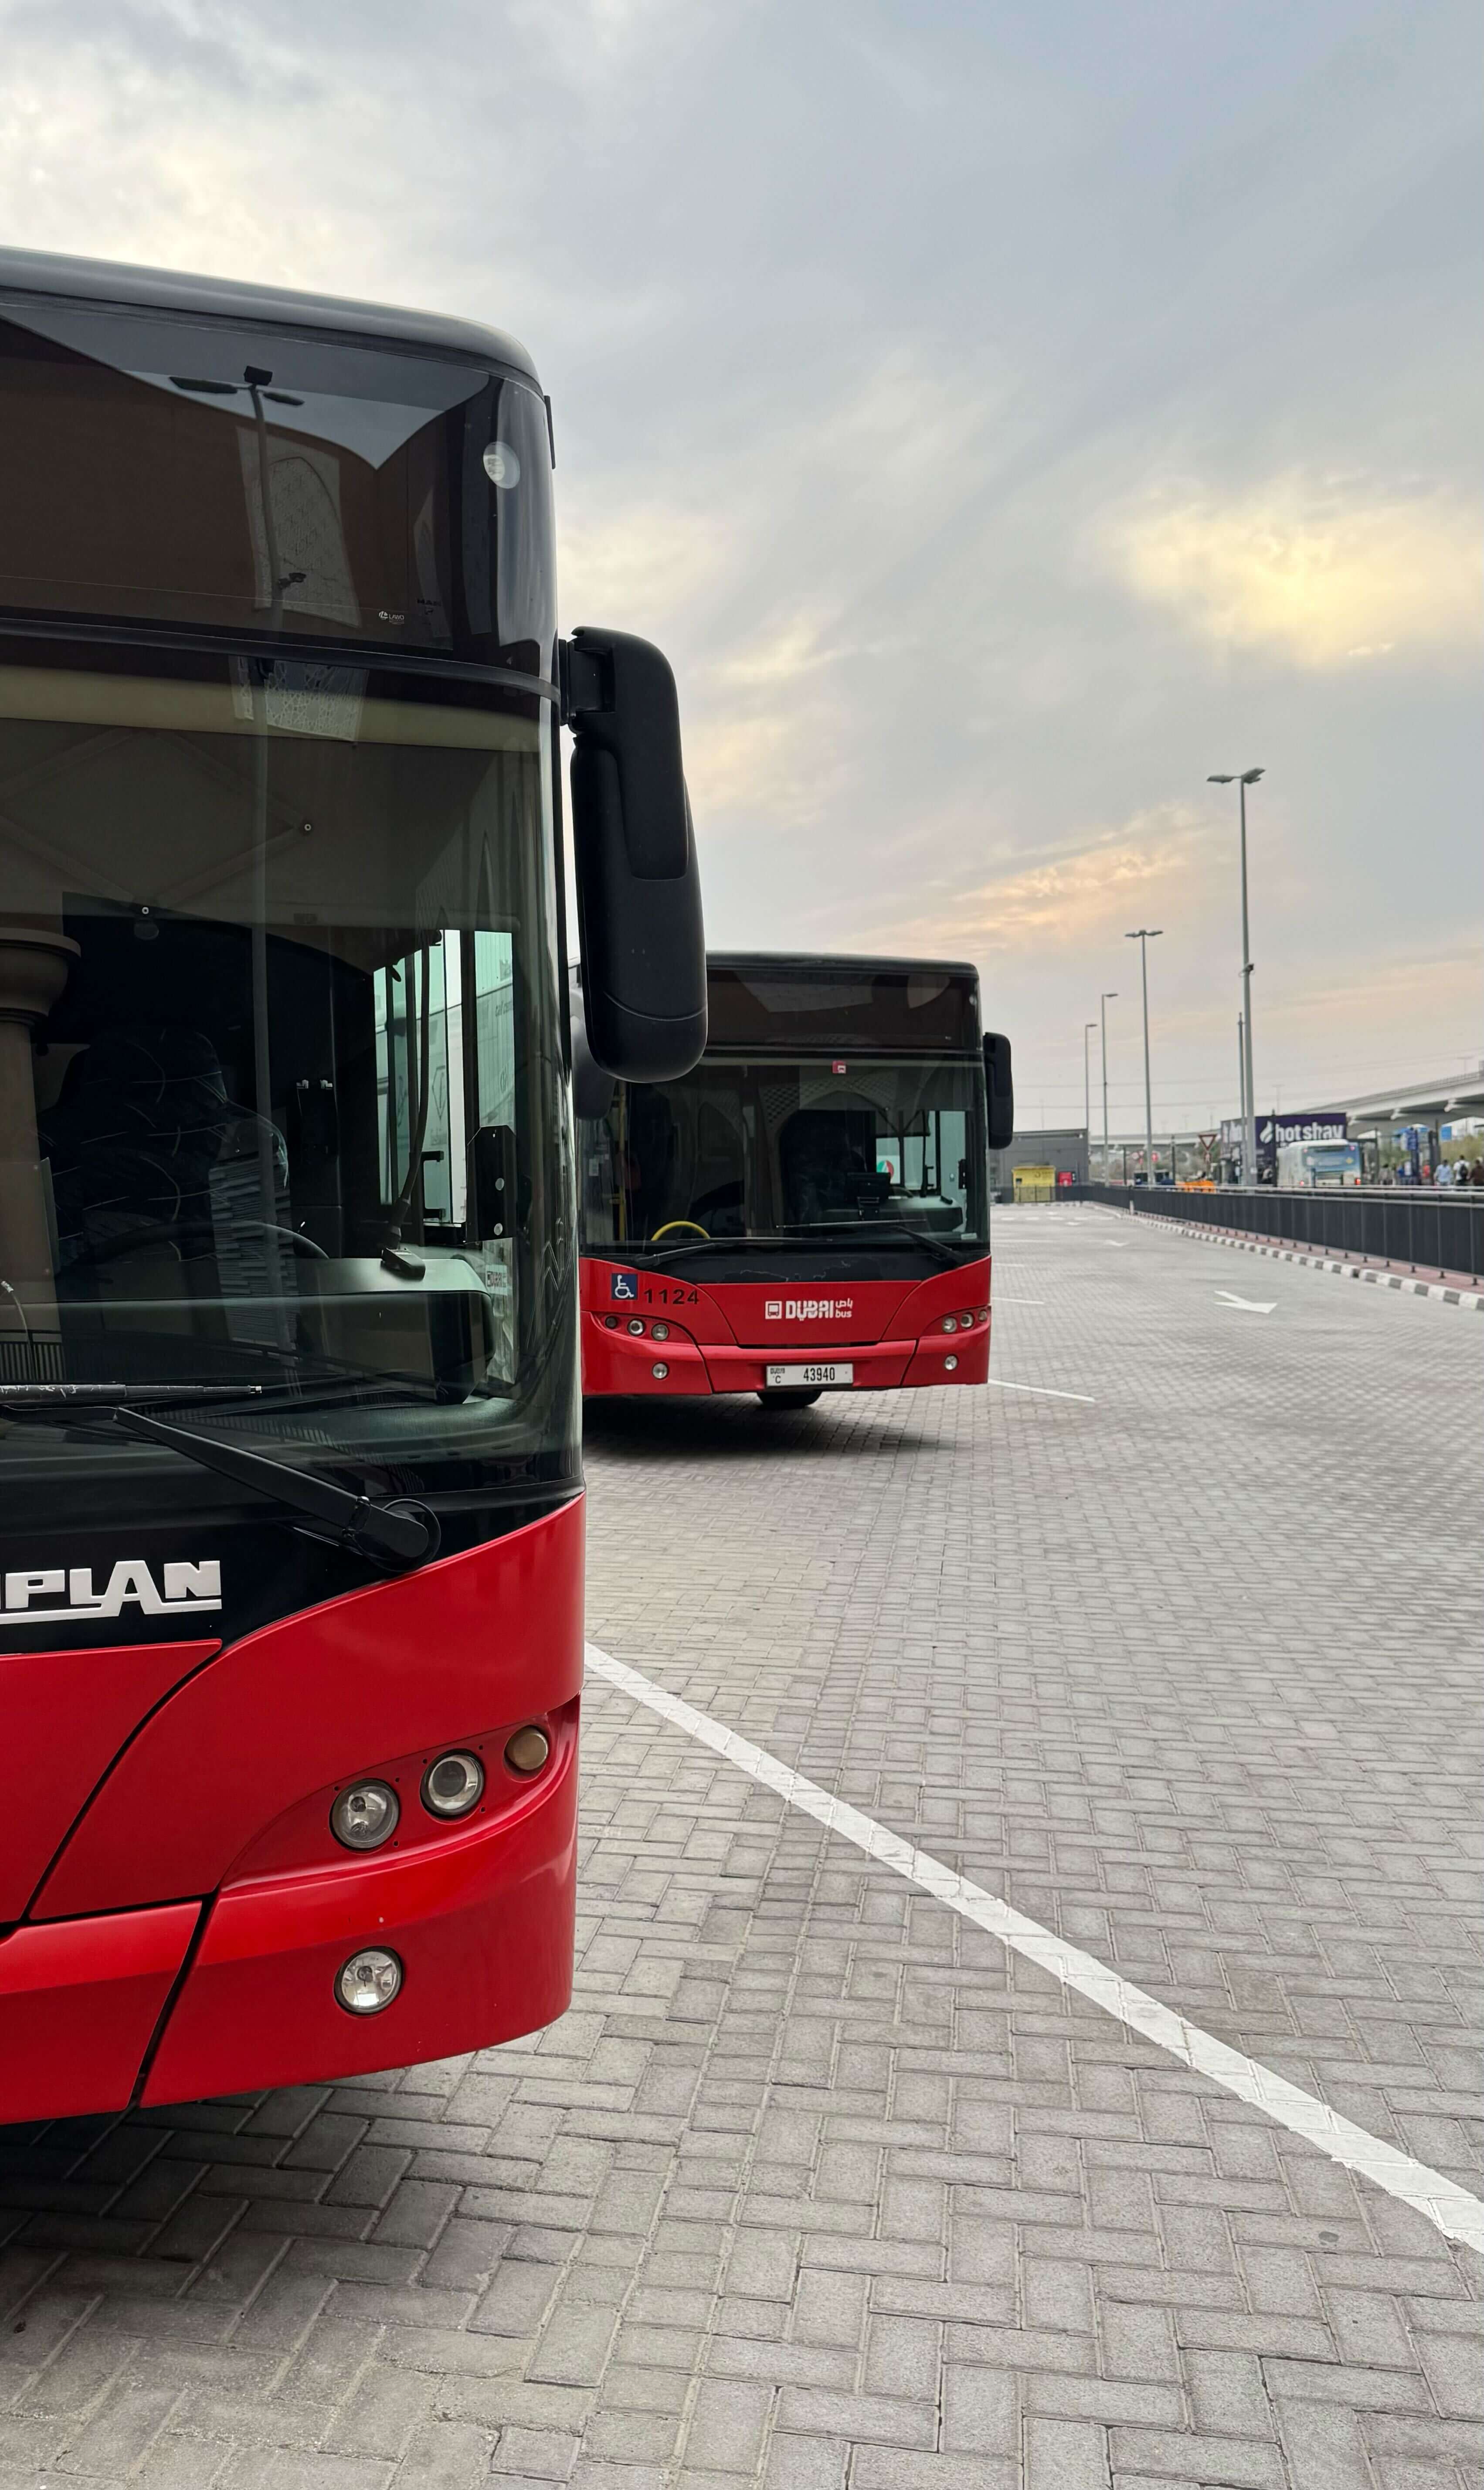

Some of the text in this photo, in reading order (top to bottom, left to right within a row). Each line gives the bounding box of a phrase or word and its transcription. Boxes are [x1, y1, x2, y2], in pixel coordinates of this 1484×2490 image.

[1275, 1124, 1301, 1142] hot
[644, 1288, 699, 1304] 1124
[785, 1300, 852, 1321] DUBAI bus
[775, 1375, 781, 1384] C
[803, 1367, 835, 1381] 43940
[0, 1560, 222, 1616] PLAN
